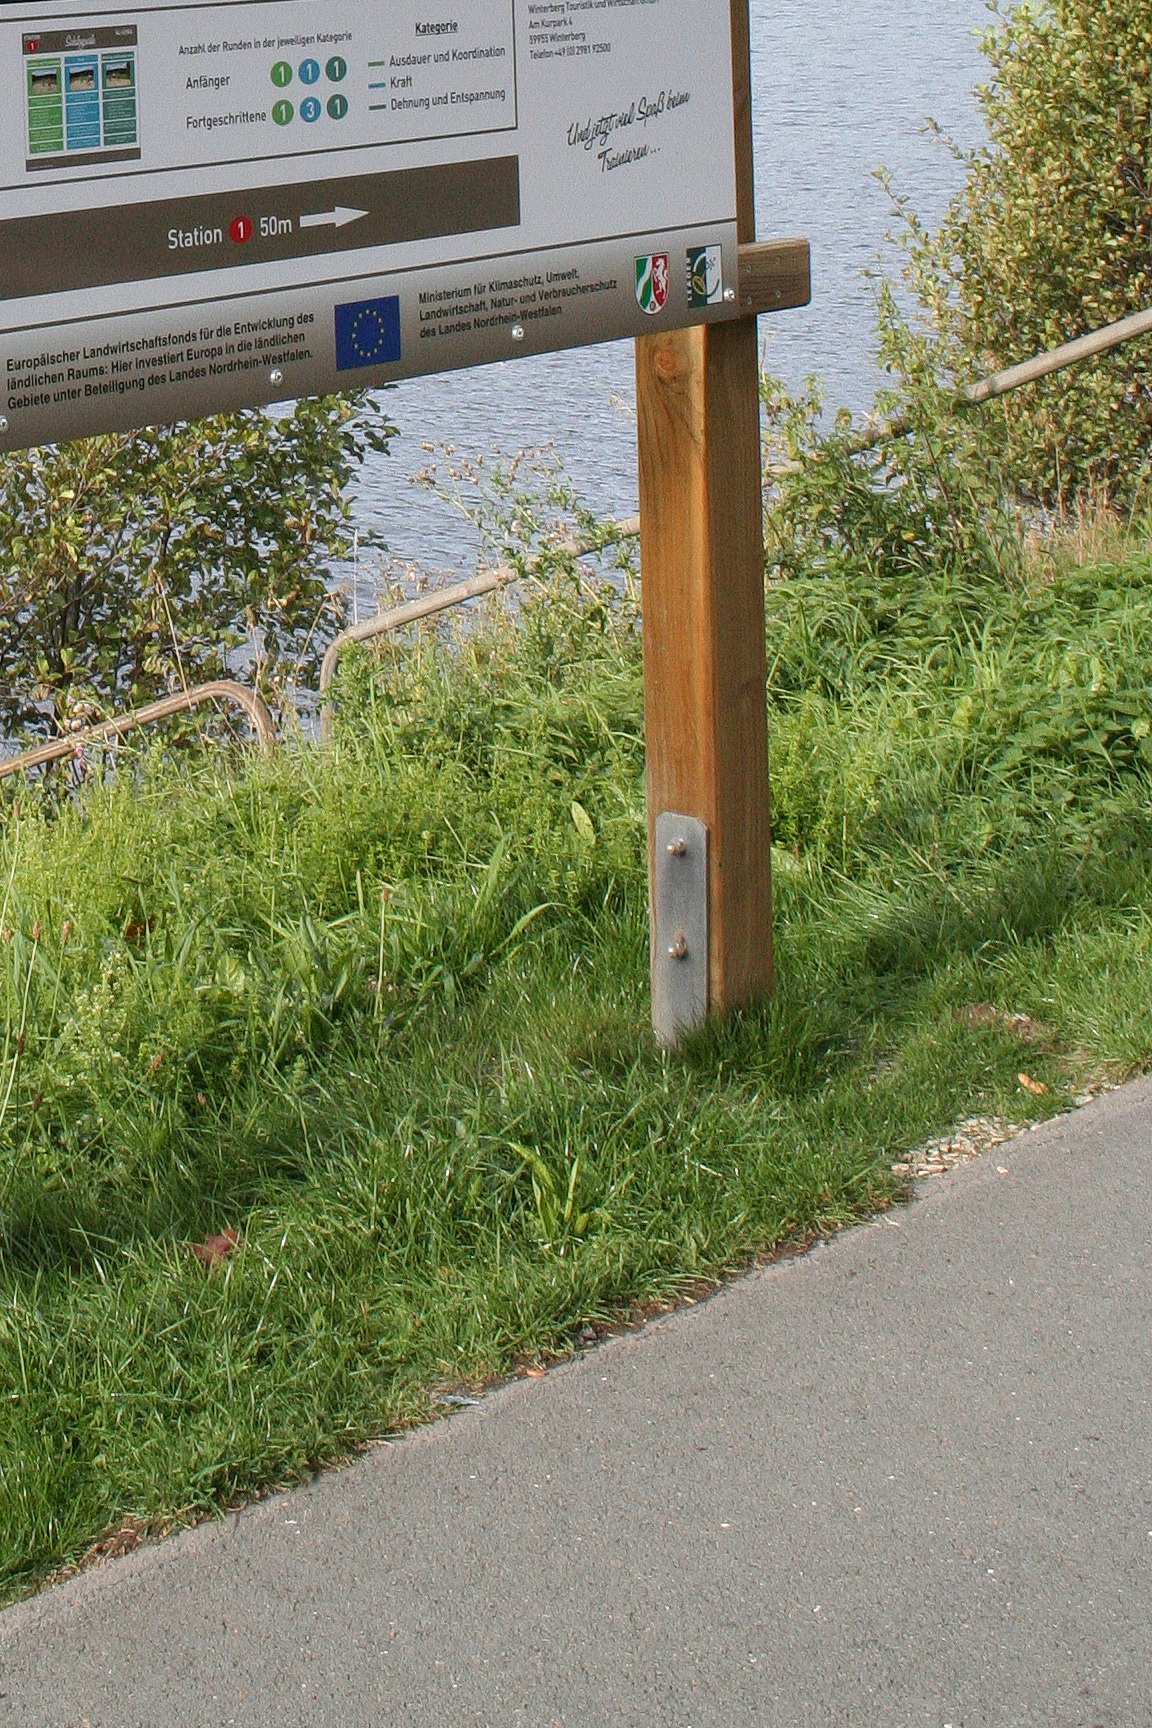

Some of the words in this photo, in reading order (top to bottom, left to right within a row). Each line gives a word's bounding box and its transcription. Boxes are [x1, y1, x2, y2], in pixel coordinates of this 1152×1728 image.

[178, 43, 205, 55] Anzahl
[207, 42, 220, 52] der
[222, 39, 252, 51] Runden
[253, 38, 261, 48] in
[262, 37, 275, 48] der
[276, 34, 315, 49] jeweiligen
[316, 31, 352, 45] Kategorie
[415, 19, 458, 36] Kategorie
[389, 52, 431, 67] Ausdauer
[433, 50, 449, 63] und
[451, 45, 505, 61] Koordination
[185, 73, 230, 92] Anfänger
[278, 65, 284, 83] 1
[306, 63, 312, 80] 1
[333, 60, 339, 77] 1
[390, 75, 412, 88] Kraft
[186, 109, 266, 132] Fortgeschrittene
[280, 104, 286, 121] 1
[306, 101, 314, 118] 3
[334, 98, 340, 115] 1
[390, 95, 429, 113] Dehnung
[431, 92, 448, 106] und
[450, 86, 505, 106] Entspannung
[566, 118, 592, 146] Und
[615, 102, 635, 129] viel
[167, 223, 222, 249] Station
[238, 221, 243, 238] 1
[260, 213, 292, 236] 50m
[418, 285, 471, 304] Ministerium
[473, 282, 486, 295] für
[419, 299, 488, 322] Landwirtschaft,
[490, 294, 517, 310] Natur-
[519, 291, 536, 304] und
[538, 278, 617, 301] Verbraucherschutz
[6, 348, 80, 372] Europäischer
[83, 329, 197, 359] Landwirtschaftsfonds
[199, 326, 214, 341] für
[215, 324, 231, 338] die
[234, 314, 294, 337] Entwicklung
[296, 311, 314, 325] des
[419, 325, 436, 339] des
[438, 319, 471, 336] Landes
[7, 369, 64, 391] ländlichen
[67, 362, 107, 381] Raums:
[111, 358, 132, 374] Hier
[135, 350, 184, 369] investiert
[186, 343, 223, 363] Europa
[225, 341, 235, 355] in
[236, 339, 252, 353] die
[254, 330, 305, 350] ländlichen
[7, 390, 50, 410] Gebiete
[53, 386, 81, 402] unter
[84, 375, 145, 400] Beteiligung
[147, 371, 166, 386] des
[169, 364, 206, 382] Landes
[208, 346, 313, 375] Nordrhein-Westfalen.
